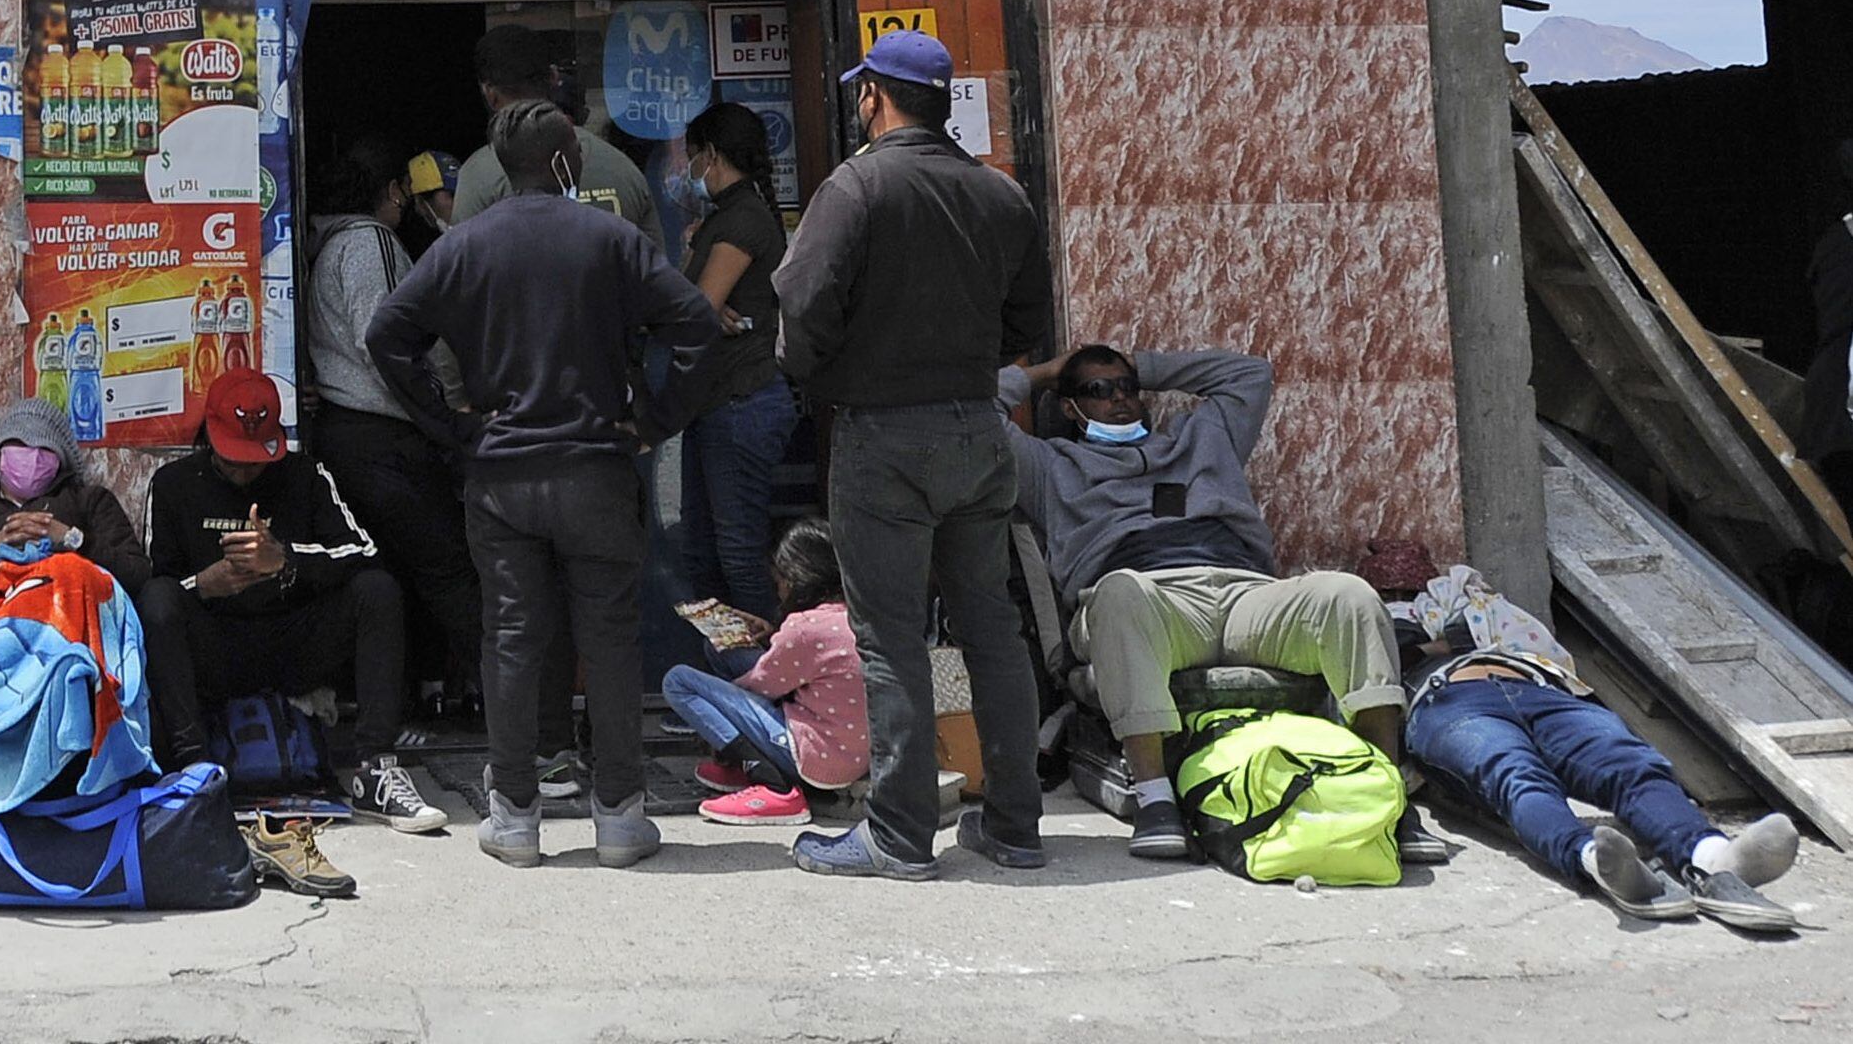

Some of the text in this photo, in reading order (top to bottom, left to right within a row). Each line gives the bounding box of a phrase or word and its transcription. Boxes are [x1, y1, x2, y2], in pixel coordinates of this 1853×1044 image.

[143, 8, 196, 34] GRATIS!
[733, 48, 757, 63] DE
[627, 67, 690, 101] Chip
[191, 86, 234, 101] Es fruta
[61, 215, 87, 226] PARA
[35, 225, 96, 244] VOLVER
[105, 222, 159, 241] GANAR
[69, 243, 88, 254] HAY
[192, 251, 247, 261] GATORADE
[57, 252, 118, 272] VOLVER
[128, 249, 180, 269] SUDAR
